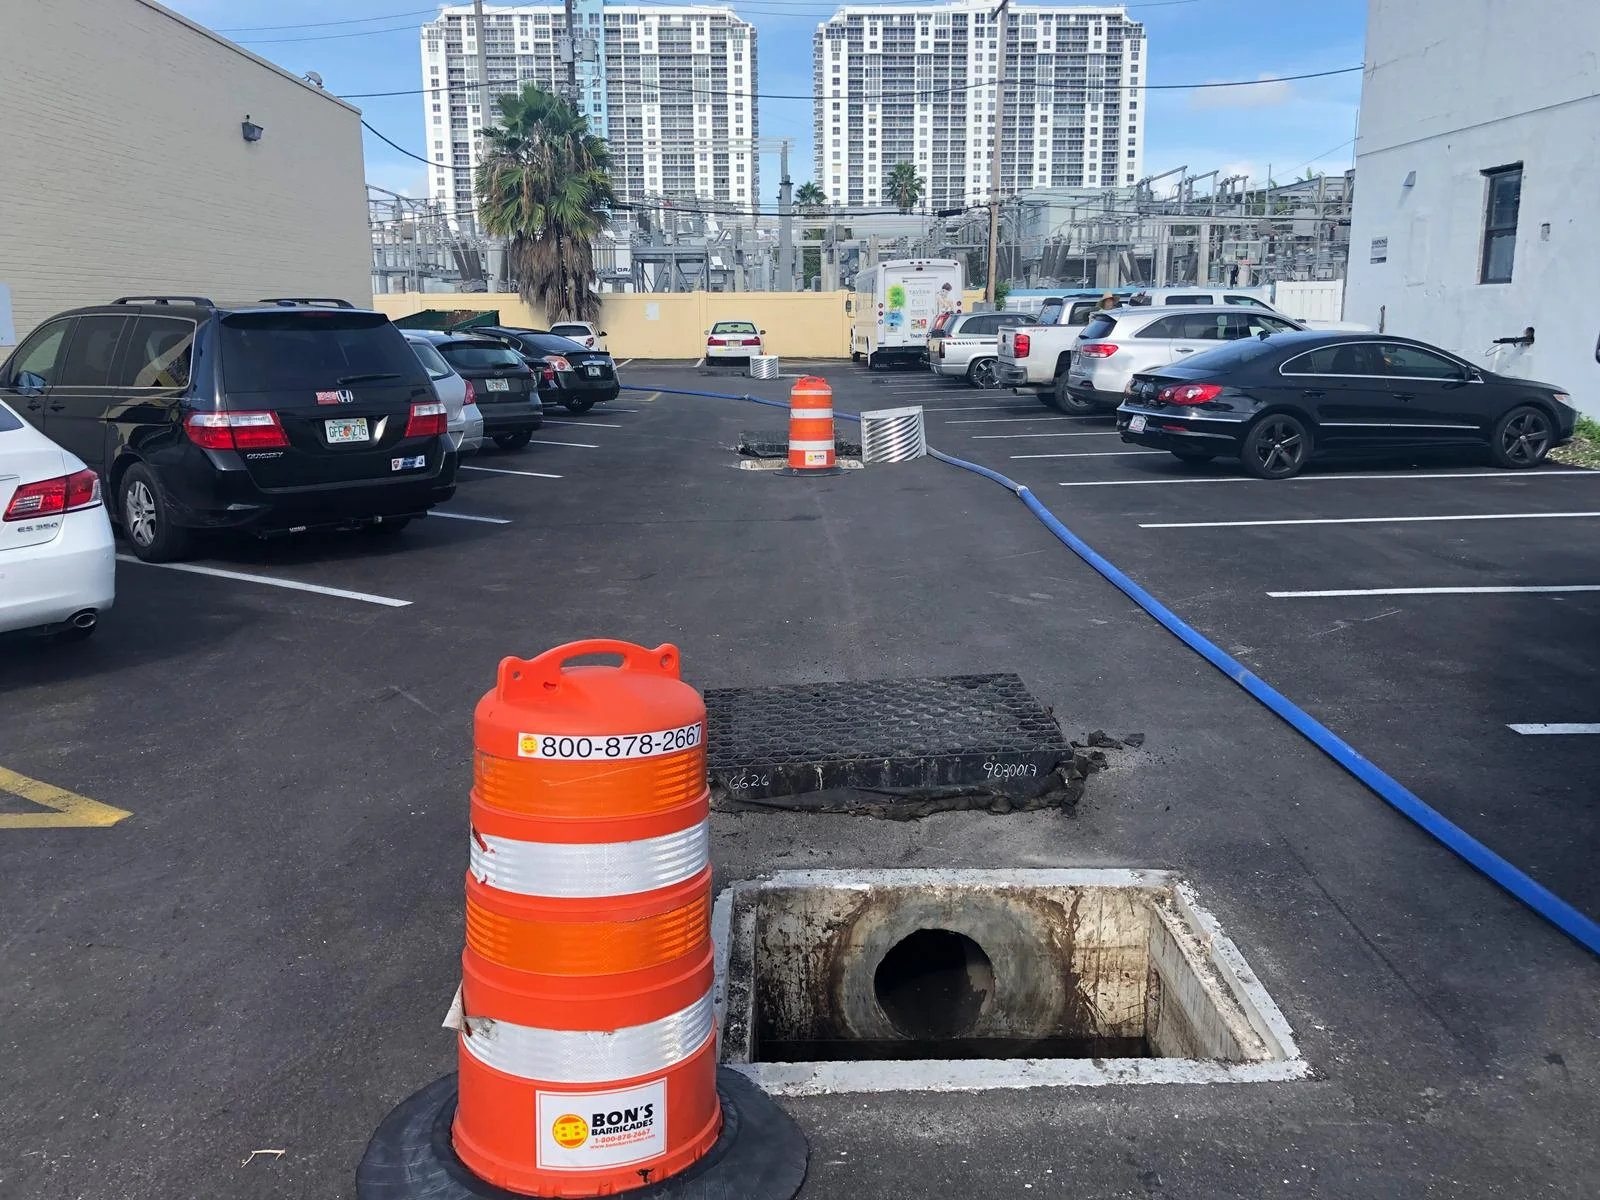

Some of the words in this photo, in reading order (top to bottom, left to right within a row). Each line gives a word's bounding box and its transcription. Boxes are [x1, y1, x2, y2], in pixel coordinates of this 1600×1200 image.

[36, 522, 59, 531] 350
[541, 723, 701, 758] 800-878-2667
[729, 774, 769, 790] 6626
[592, 1103, 654, 1128] BON'S
[591, 1118, 653, 1136] BARRICADES
[595, 1128, 651, 1143] 1-800-878-2667
